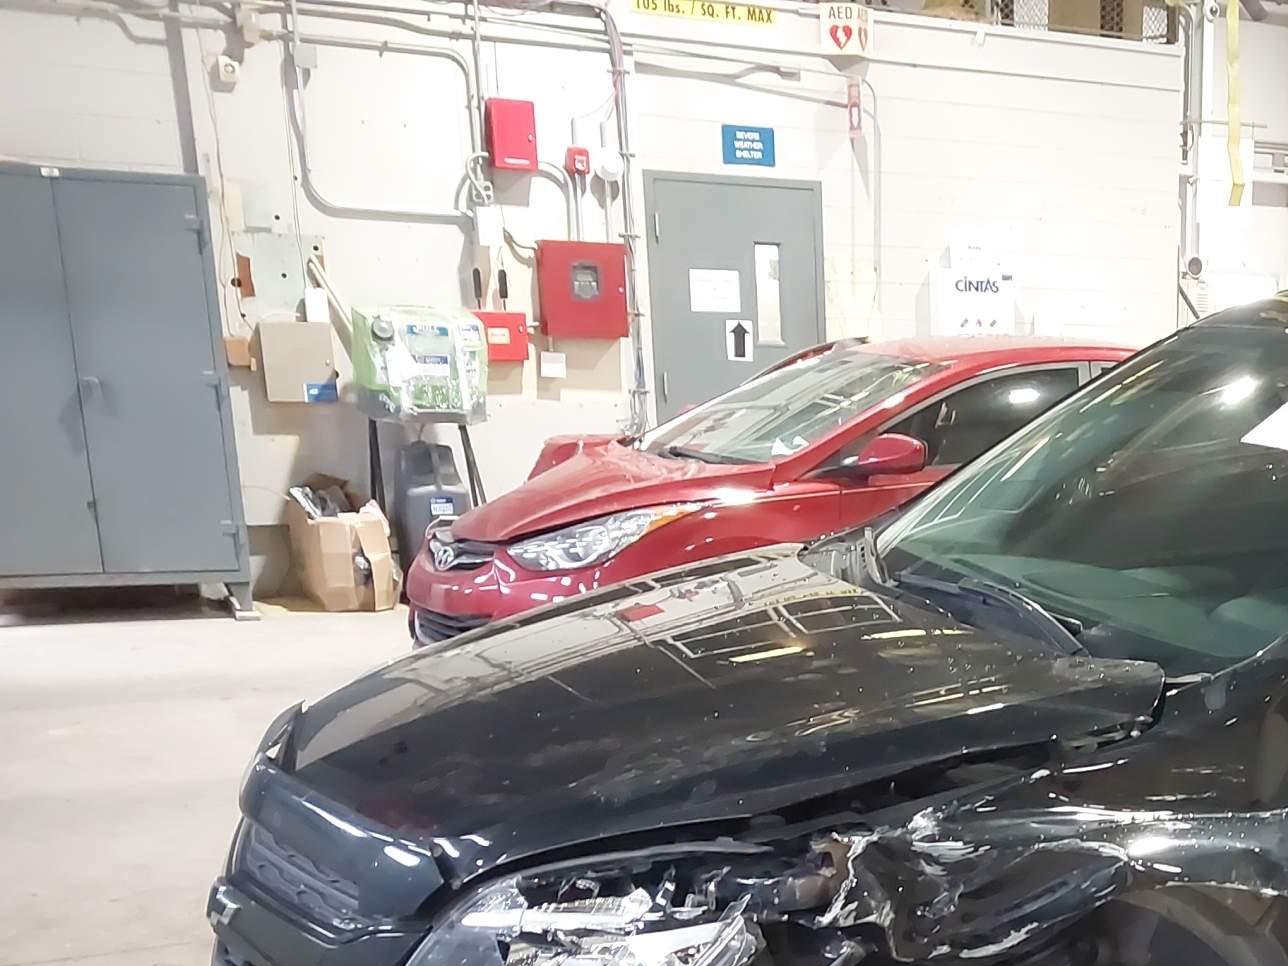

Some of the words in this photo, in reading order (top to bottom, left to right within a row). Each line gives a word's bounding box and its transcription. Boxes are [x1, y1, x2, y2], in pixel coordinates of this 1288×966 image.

[636, 0, 658, 10] 105
[663, 0, 685, 14] lbs.
[700, 3, 720, 18] SQ.
[725, 5, 742, 20] FT.
[747, 7, 773, 23] MAX
[828, 5, 853, 20] AED
[955, 275, 1000, 294] CINTAS
